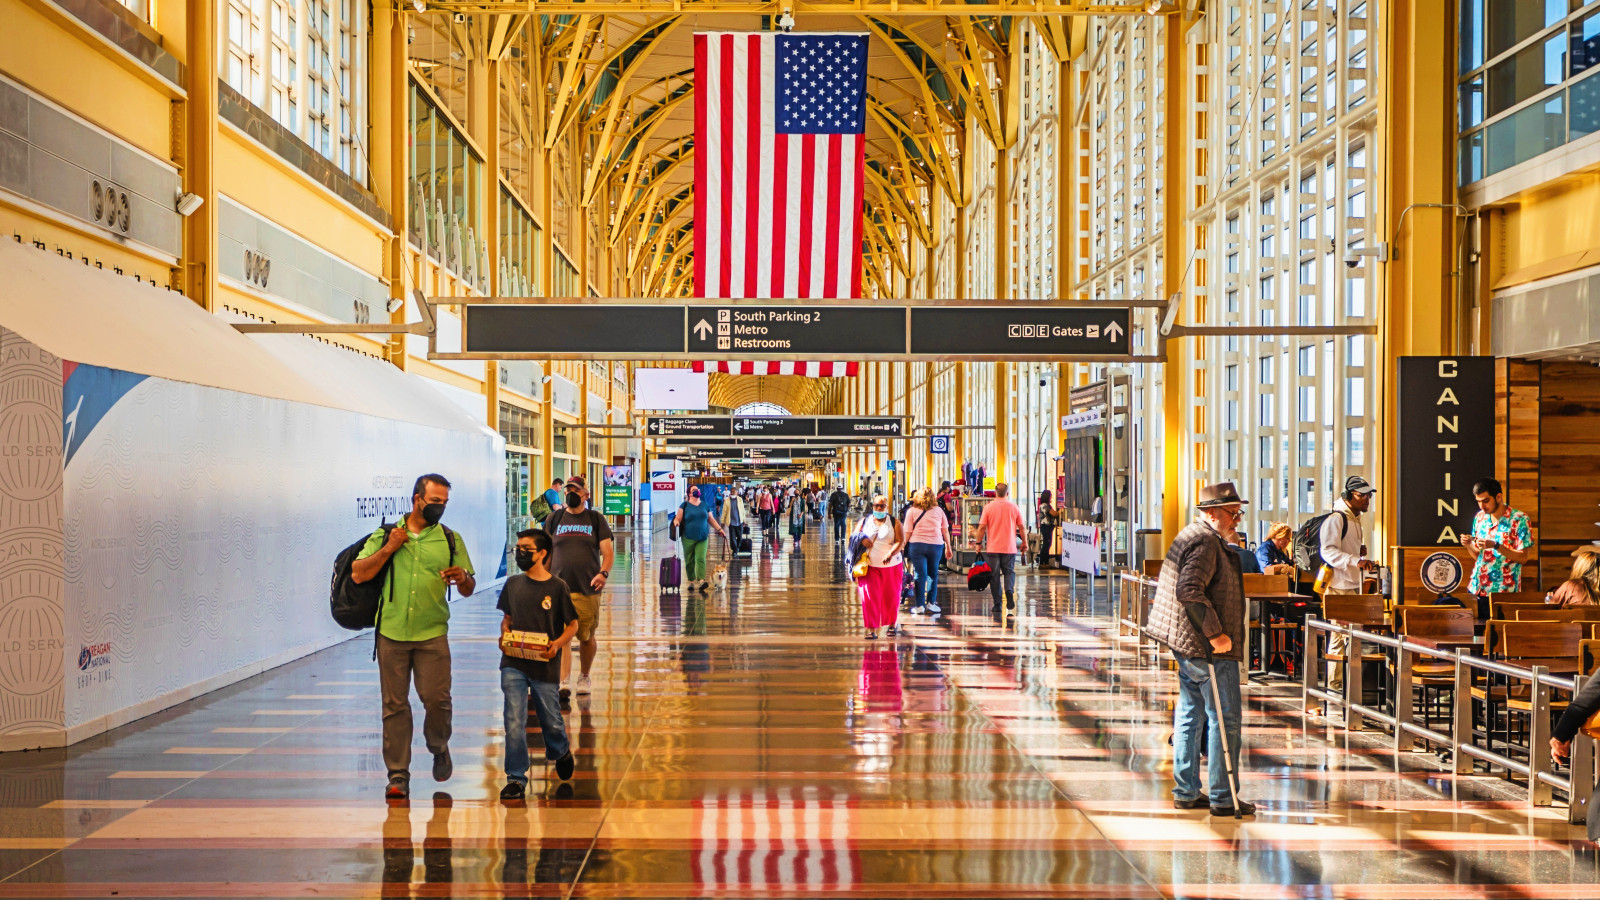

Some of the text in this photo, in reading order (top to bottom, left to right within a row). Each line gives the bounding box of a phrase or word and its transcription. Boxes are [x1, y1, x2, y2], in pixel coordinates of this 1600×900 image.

[734, 311, 766, 322] South
[769, 311, 811, 324] Parking
[813, 311, 821, 322] 2
[734, 324, 768, 335] Metro
[1052, 326, 1084, 337] Gates
[734, 338, 791, 348] Restrooms
[1436, 360, 1460, 544] CANTINA
[356, 496, 412, 518] THE CENTURION LOUN
[90, 642, 111, 657] REAGAN
[92, 656, 111, 668] NATIONAL
